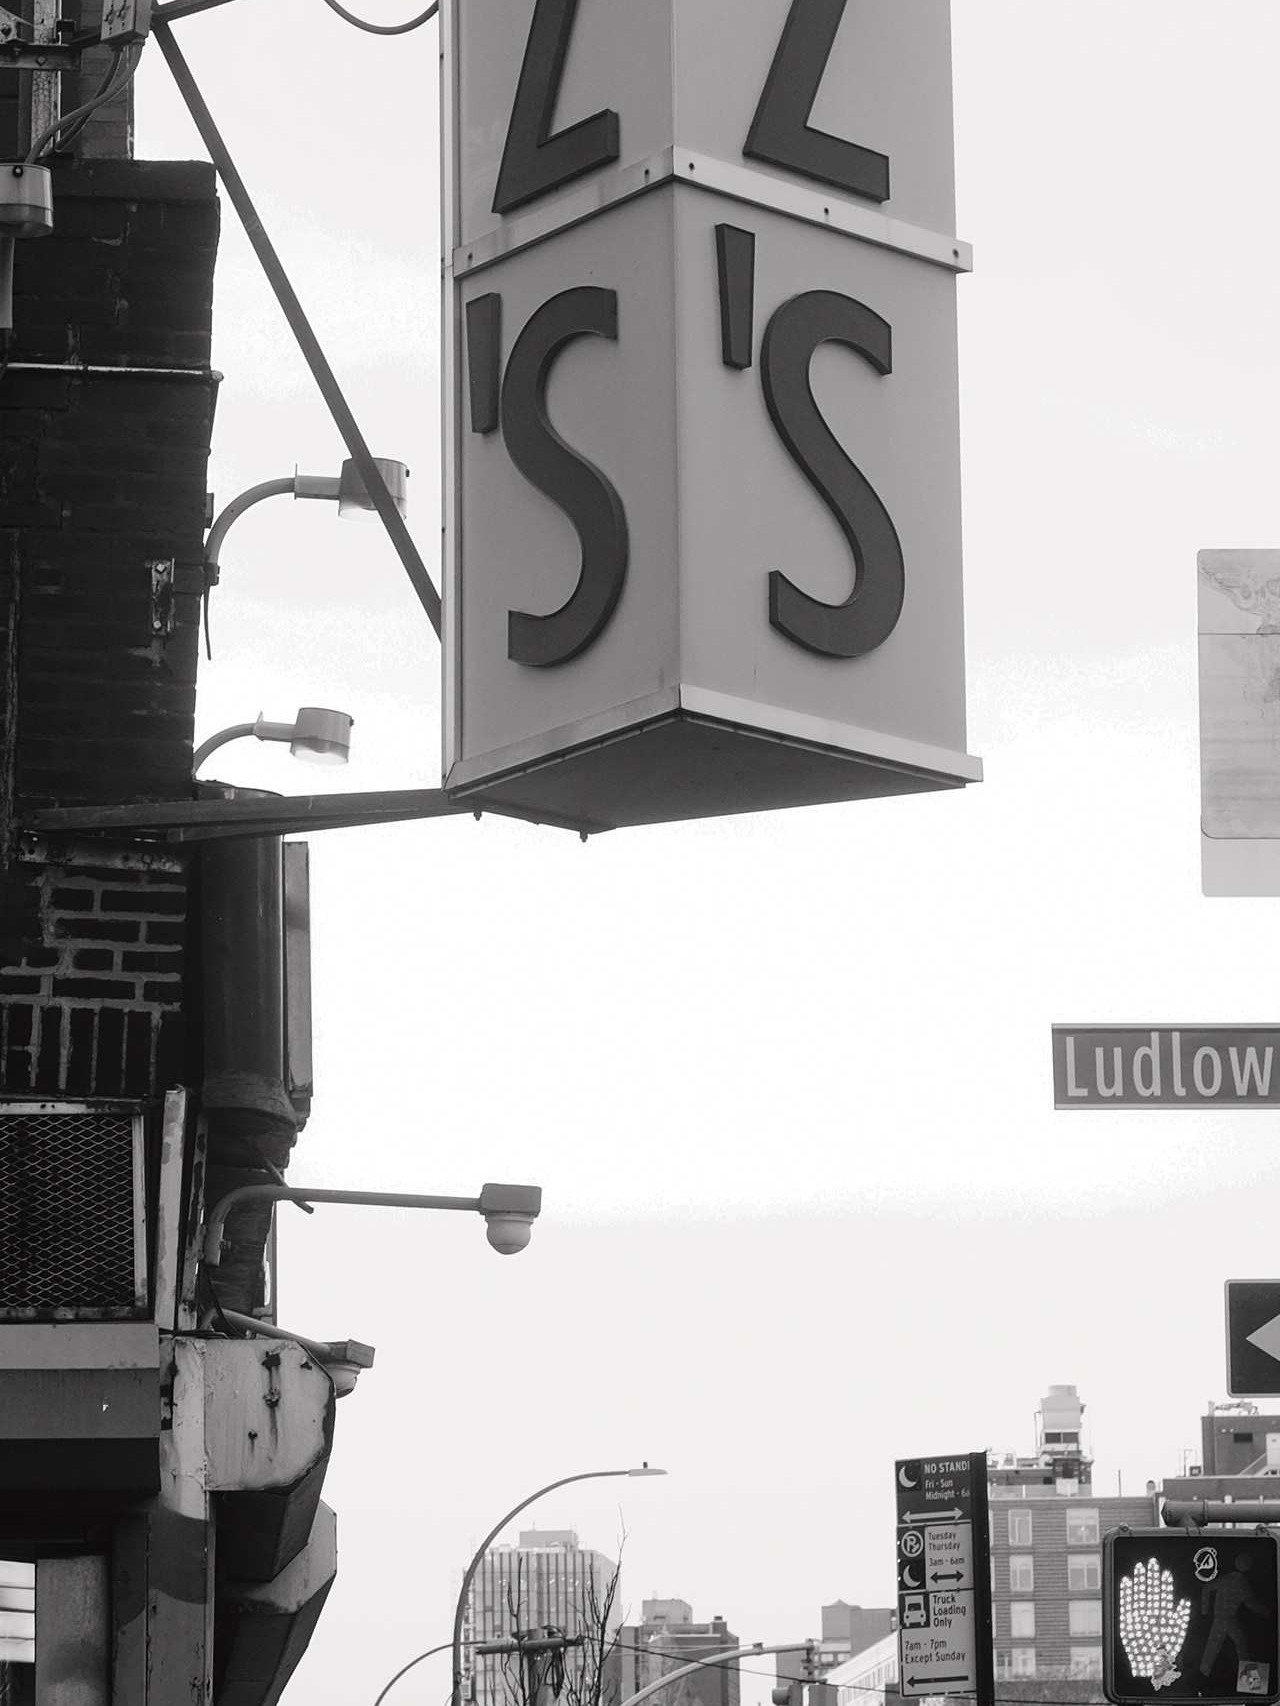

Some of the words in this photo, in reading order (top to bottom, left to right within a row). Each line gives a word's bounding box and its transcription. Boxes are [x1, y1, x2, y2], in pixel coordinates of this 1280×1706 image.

[1065, 1031, 1274, 1097] Ludlow
[924, 1463, 937, 1475] NO
[925, 1479, 935, 1489] Fri
[940, 1479, 954, 1488] Sun
[925, 1489, 955, 1501] Midnight
[928, 1532, 956, 1542] Tuesday
[928, 1542, 961, 1551] Thursday
[929, 1557, 944, 1566] 3am
[950, 1556, 965, 1566] 6am
[933, 1594, 956, 1604] Truck
[933, 1605, 966, 1618] Loading
[933, 1617, 953, 1629] Only
[905, 1641, 921, 1651] 7am
[929, 1639, 947, 1651] 7pm
[905, 1653, 933, 1665] Except
[935, 1651, 966, 1663] Sunday
